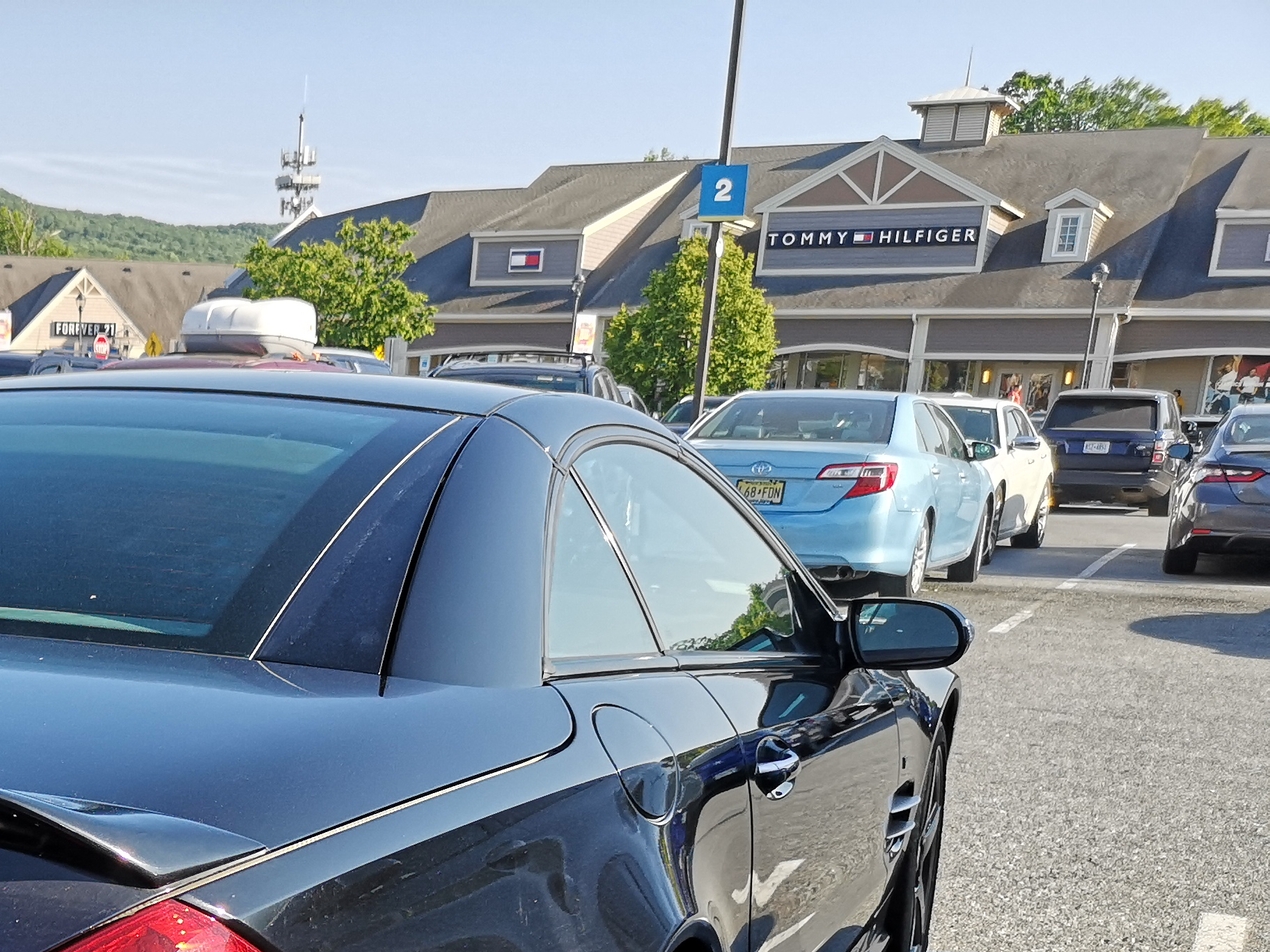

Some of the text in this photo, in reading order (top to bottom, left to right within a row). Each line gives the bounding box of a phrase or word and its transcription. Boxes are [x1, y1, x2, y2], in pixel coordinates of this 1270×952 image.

[714, 177, 733, 202] 2
[768, 229, 976, 246] TOMMY HILFIGER
[55, 322, 115, 336] FOREVER 21
